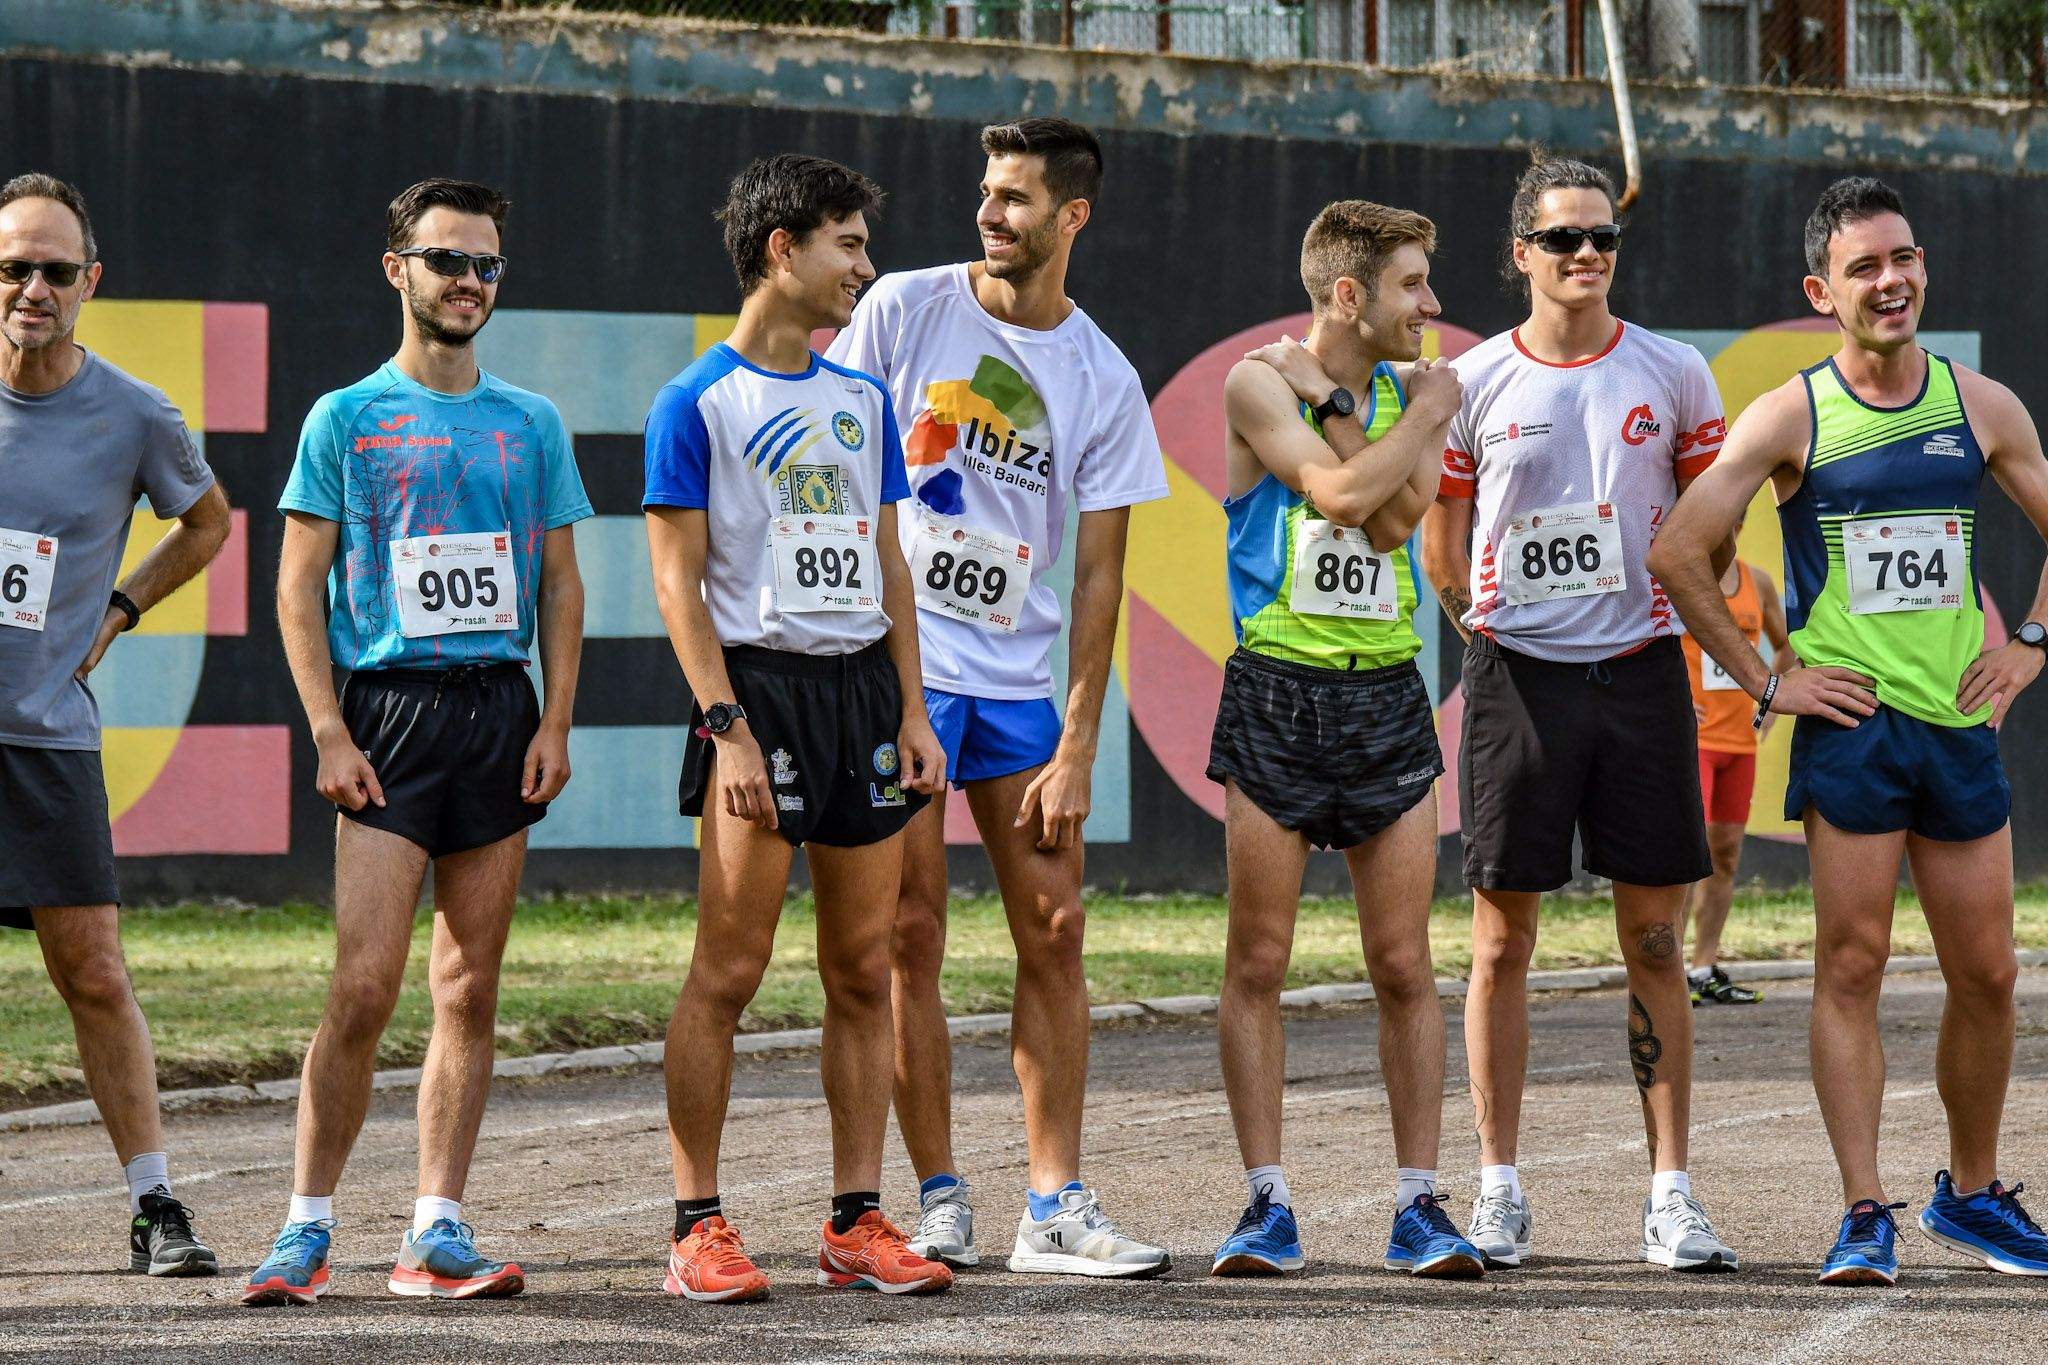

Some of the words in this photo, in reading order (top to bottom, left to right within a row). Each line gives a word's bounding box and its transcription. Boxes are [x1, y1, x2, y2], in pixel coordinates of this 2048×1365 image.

[966, 417, 1051, 479] Ibiza
[1636, 421, 1660, 434] FNA
[777, 471, 791, 514] RUPO
[963, 454, 991, 475] Illes
[994, 467, 1047, 497] Balears
[795, 547, 861, 589] 892
[1315, 552, 1381, 596] 867
[1522, 534, 1600, 579] 866
[1868, 548, 1948, 590] 764
[418, 567, 498, 612] 905
[926, 551, 1007, 605] 869
[1596, 575, 1620, 586] 2023
[1941, 594, 1960, 604] 2023
[15, 611, 39, 623] 2023
[494, 613, 513, 623] 2023
[858, 596, 873, 606] 2023
[989, 613, 1012, 626] 2023
[1378, 604, 1393, 613] 2023
